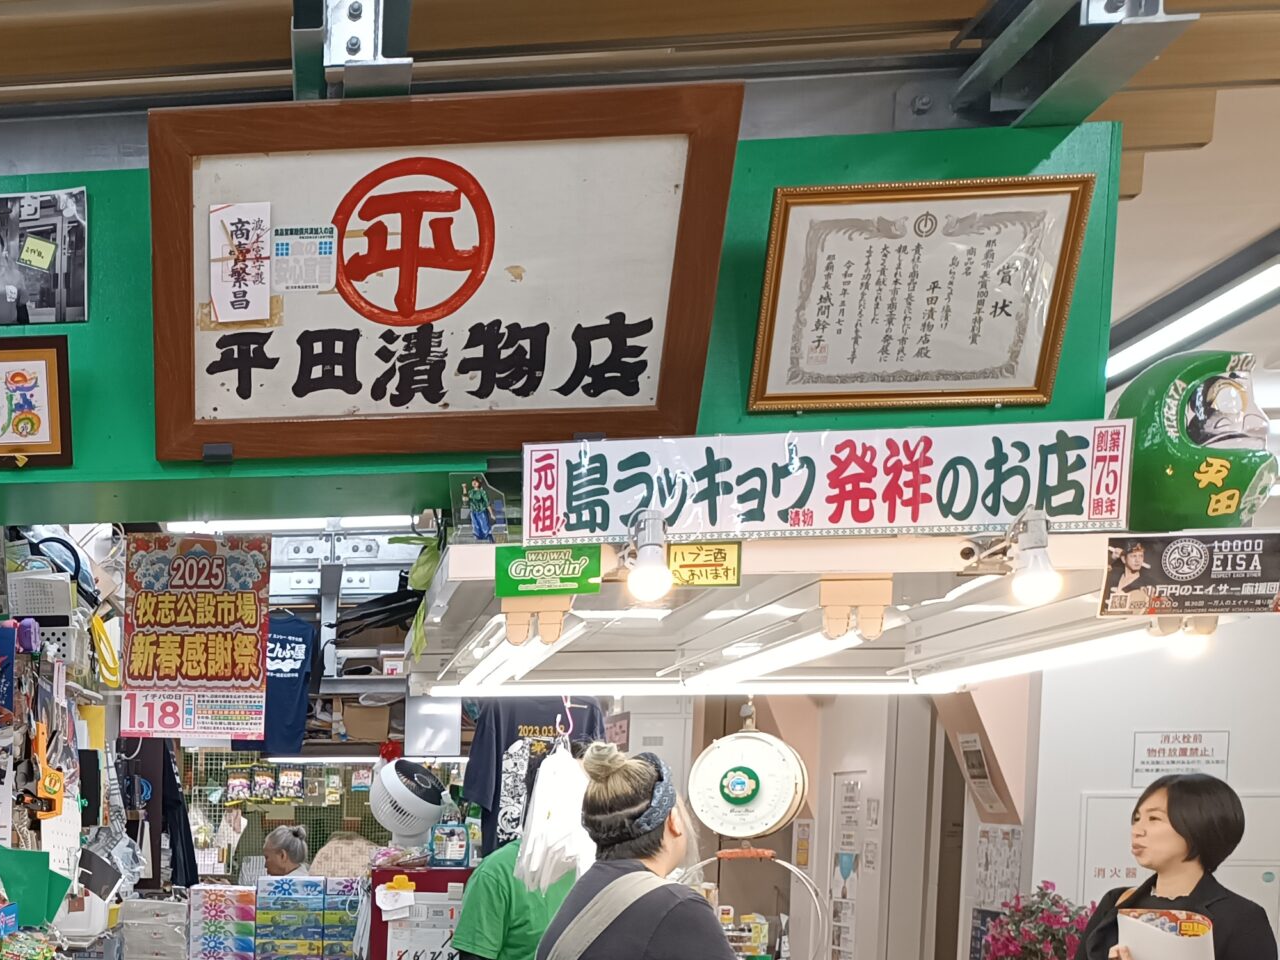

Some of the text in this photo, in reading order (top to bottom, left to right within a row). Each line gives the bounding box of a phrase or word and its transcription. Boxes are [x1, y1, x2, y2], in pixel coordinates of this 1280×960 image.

[206, 312, 654, 406] 平田漬物店
[1096, 429, 1122, 451] 創業
[1093, 456, 1119, 497] 75
[1091, 497, 1117, 516] 周年
[526, 549, 571, 562] WAI WAI
[673, 547, 728, 563] ハブ酒
[1212, 539, 1264, 553] 10000
[1211, 554, 1263, 572] EISA
[171, 558, 224, 589] 2025
[135, 592, 258, 627] 牧志公設市場
[128, 633, 261, 679] 新春感謝祭
[142, 693, 182, 701] イチバの日
[124, 693, 181, 729] 1.18
[185, 697, 193, 727] 土曜日
[1160, 734, 1203, 745] 消火栓前
[1147, 747, 1215, 758] 物件放置禁止!
[1093, 867, 1137, 879] 消火器
